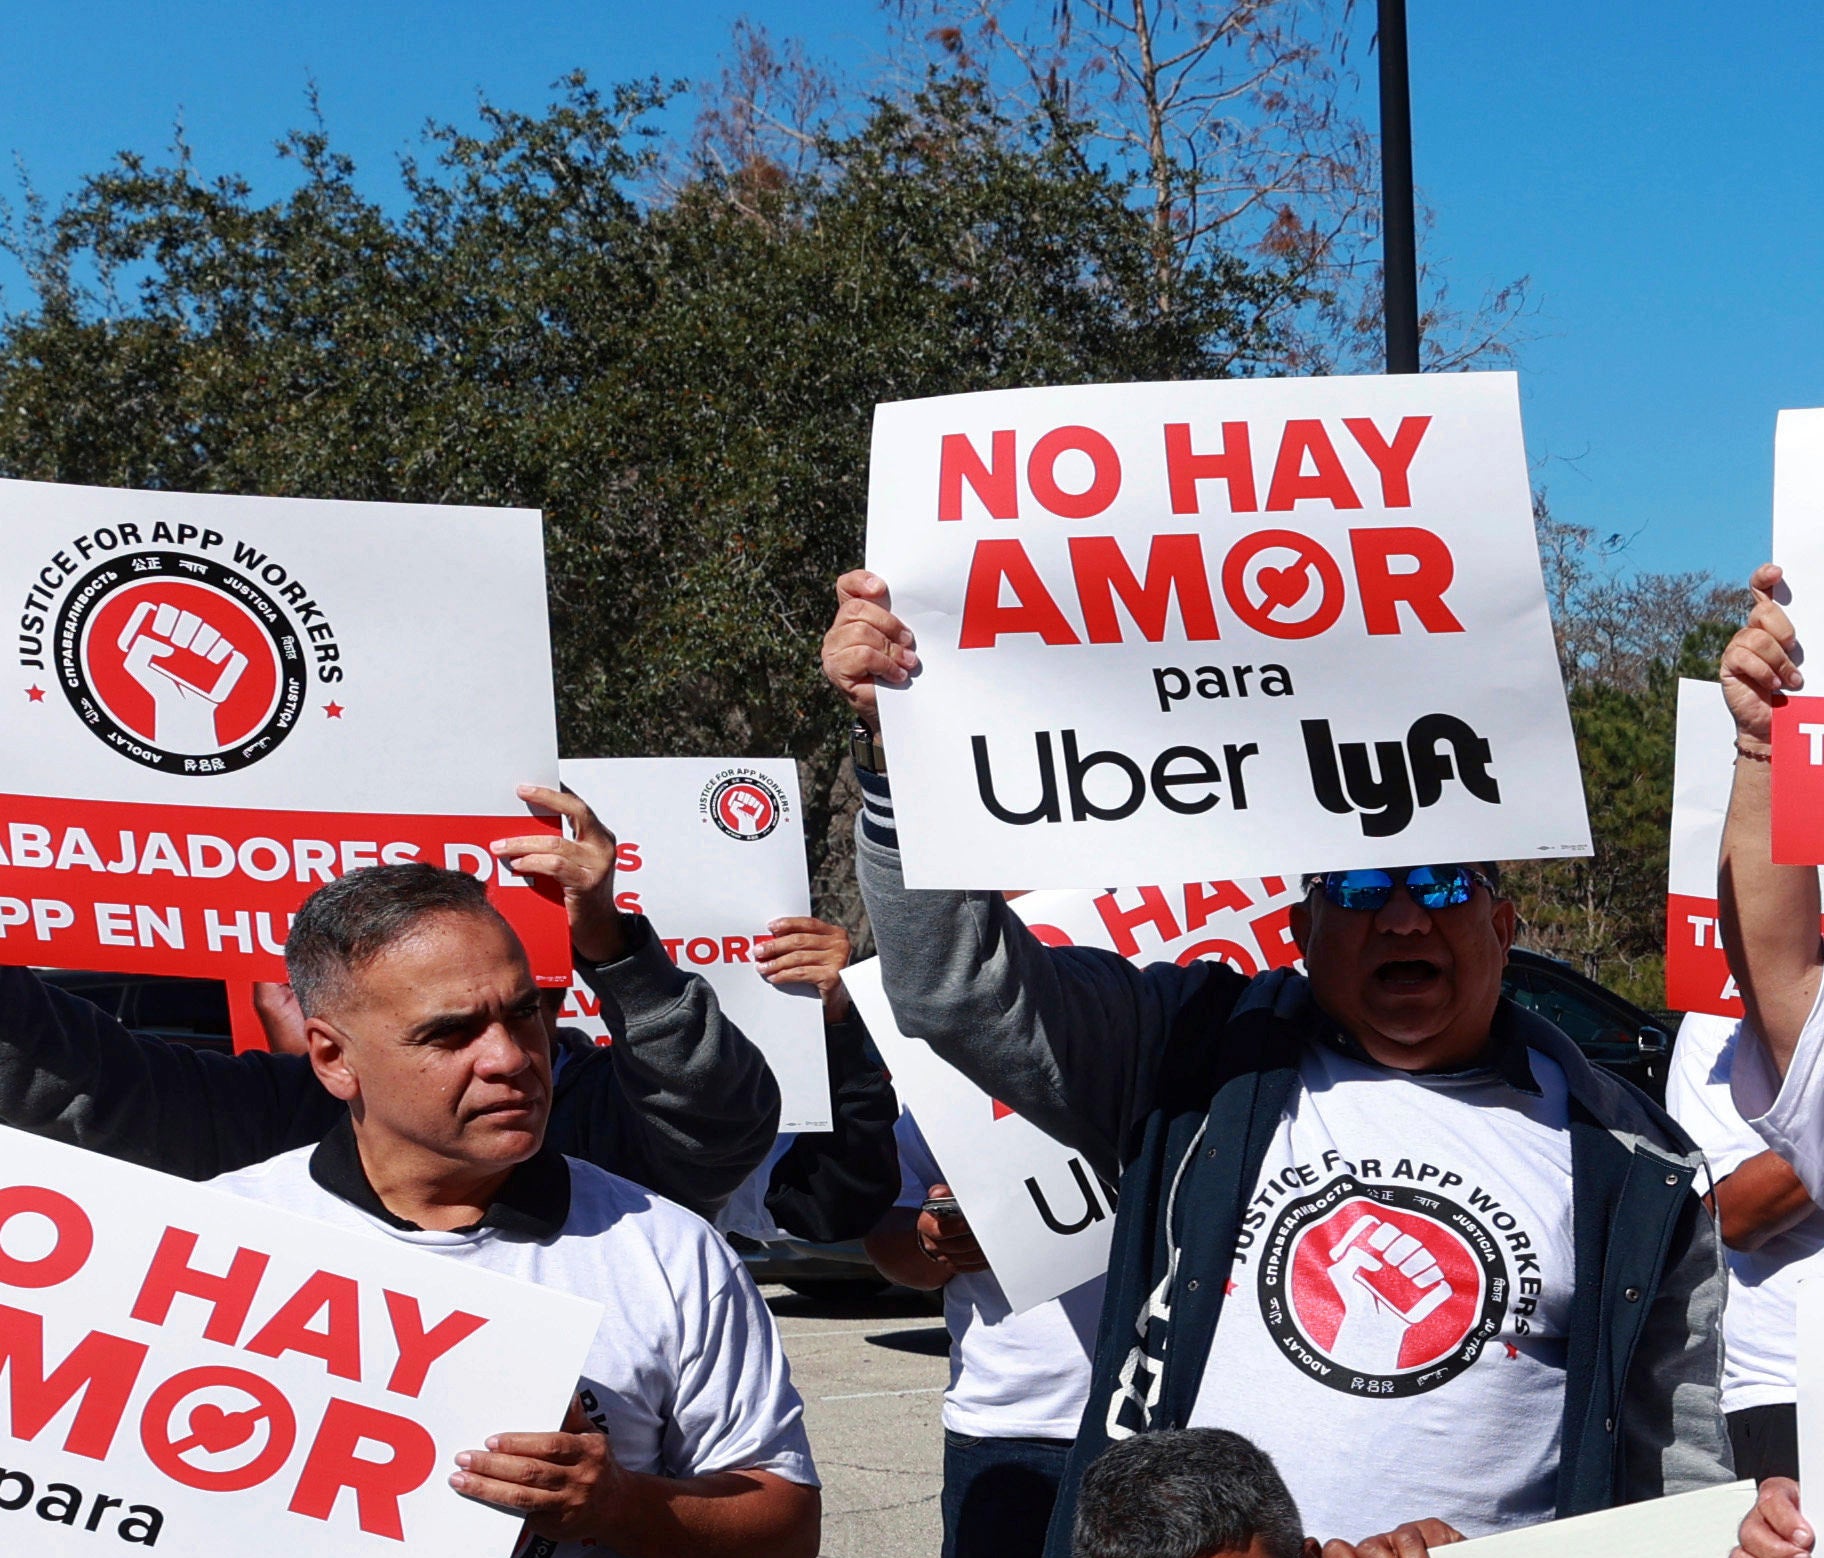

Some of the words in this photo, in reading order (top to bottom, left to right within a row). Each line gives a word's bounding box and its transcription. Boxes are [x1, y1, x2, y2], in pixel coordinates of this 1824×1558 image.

[937, 424, 1123, 523] NO
[1163, 415, 1434, 514] HAY
[19, 551, 77, 670] JUSTICE
[73, 522, 141, 560] FOR
[152, 521, 224, 550] APP
[232, 541, 343, 684] WORKERS
[224, 576, 278, 623] JUSTICIA
[958, 526, 1467, 650] AMOR
[1152, 663, 1295, 713] para
[108, 732, 162, 763] ADOLAT
[699, 778, 716, 813] JUSTICE
[716, 769, 734, 780] FOR
[737, 768, 756, 776] APP
[759, 773, 790, 813] WORKERS
[971, 730, 1259, 827] Uber
[1300, 713, 1502, 838] lyft
[93, 902, 185, 950] EN
[1234, 1163, 1320, 1264] JUSTICE
[1392, 1158, 1463, 1188] APP
[1467, 1186, 1542, 1336] WORKERS
[1266, 1181, 1353, 1285] СПРАВЕДЛИВОСТЬ
[1452, 1213, 1497, 1263] JUSTICIA
[131, 1225, 490, 1400] HAY
[1283, 1336, 1331, 1376] ADOLAT
[1351, 1376, 1394, 1394] 정당성
